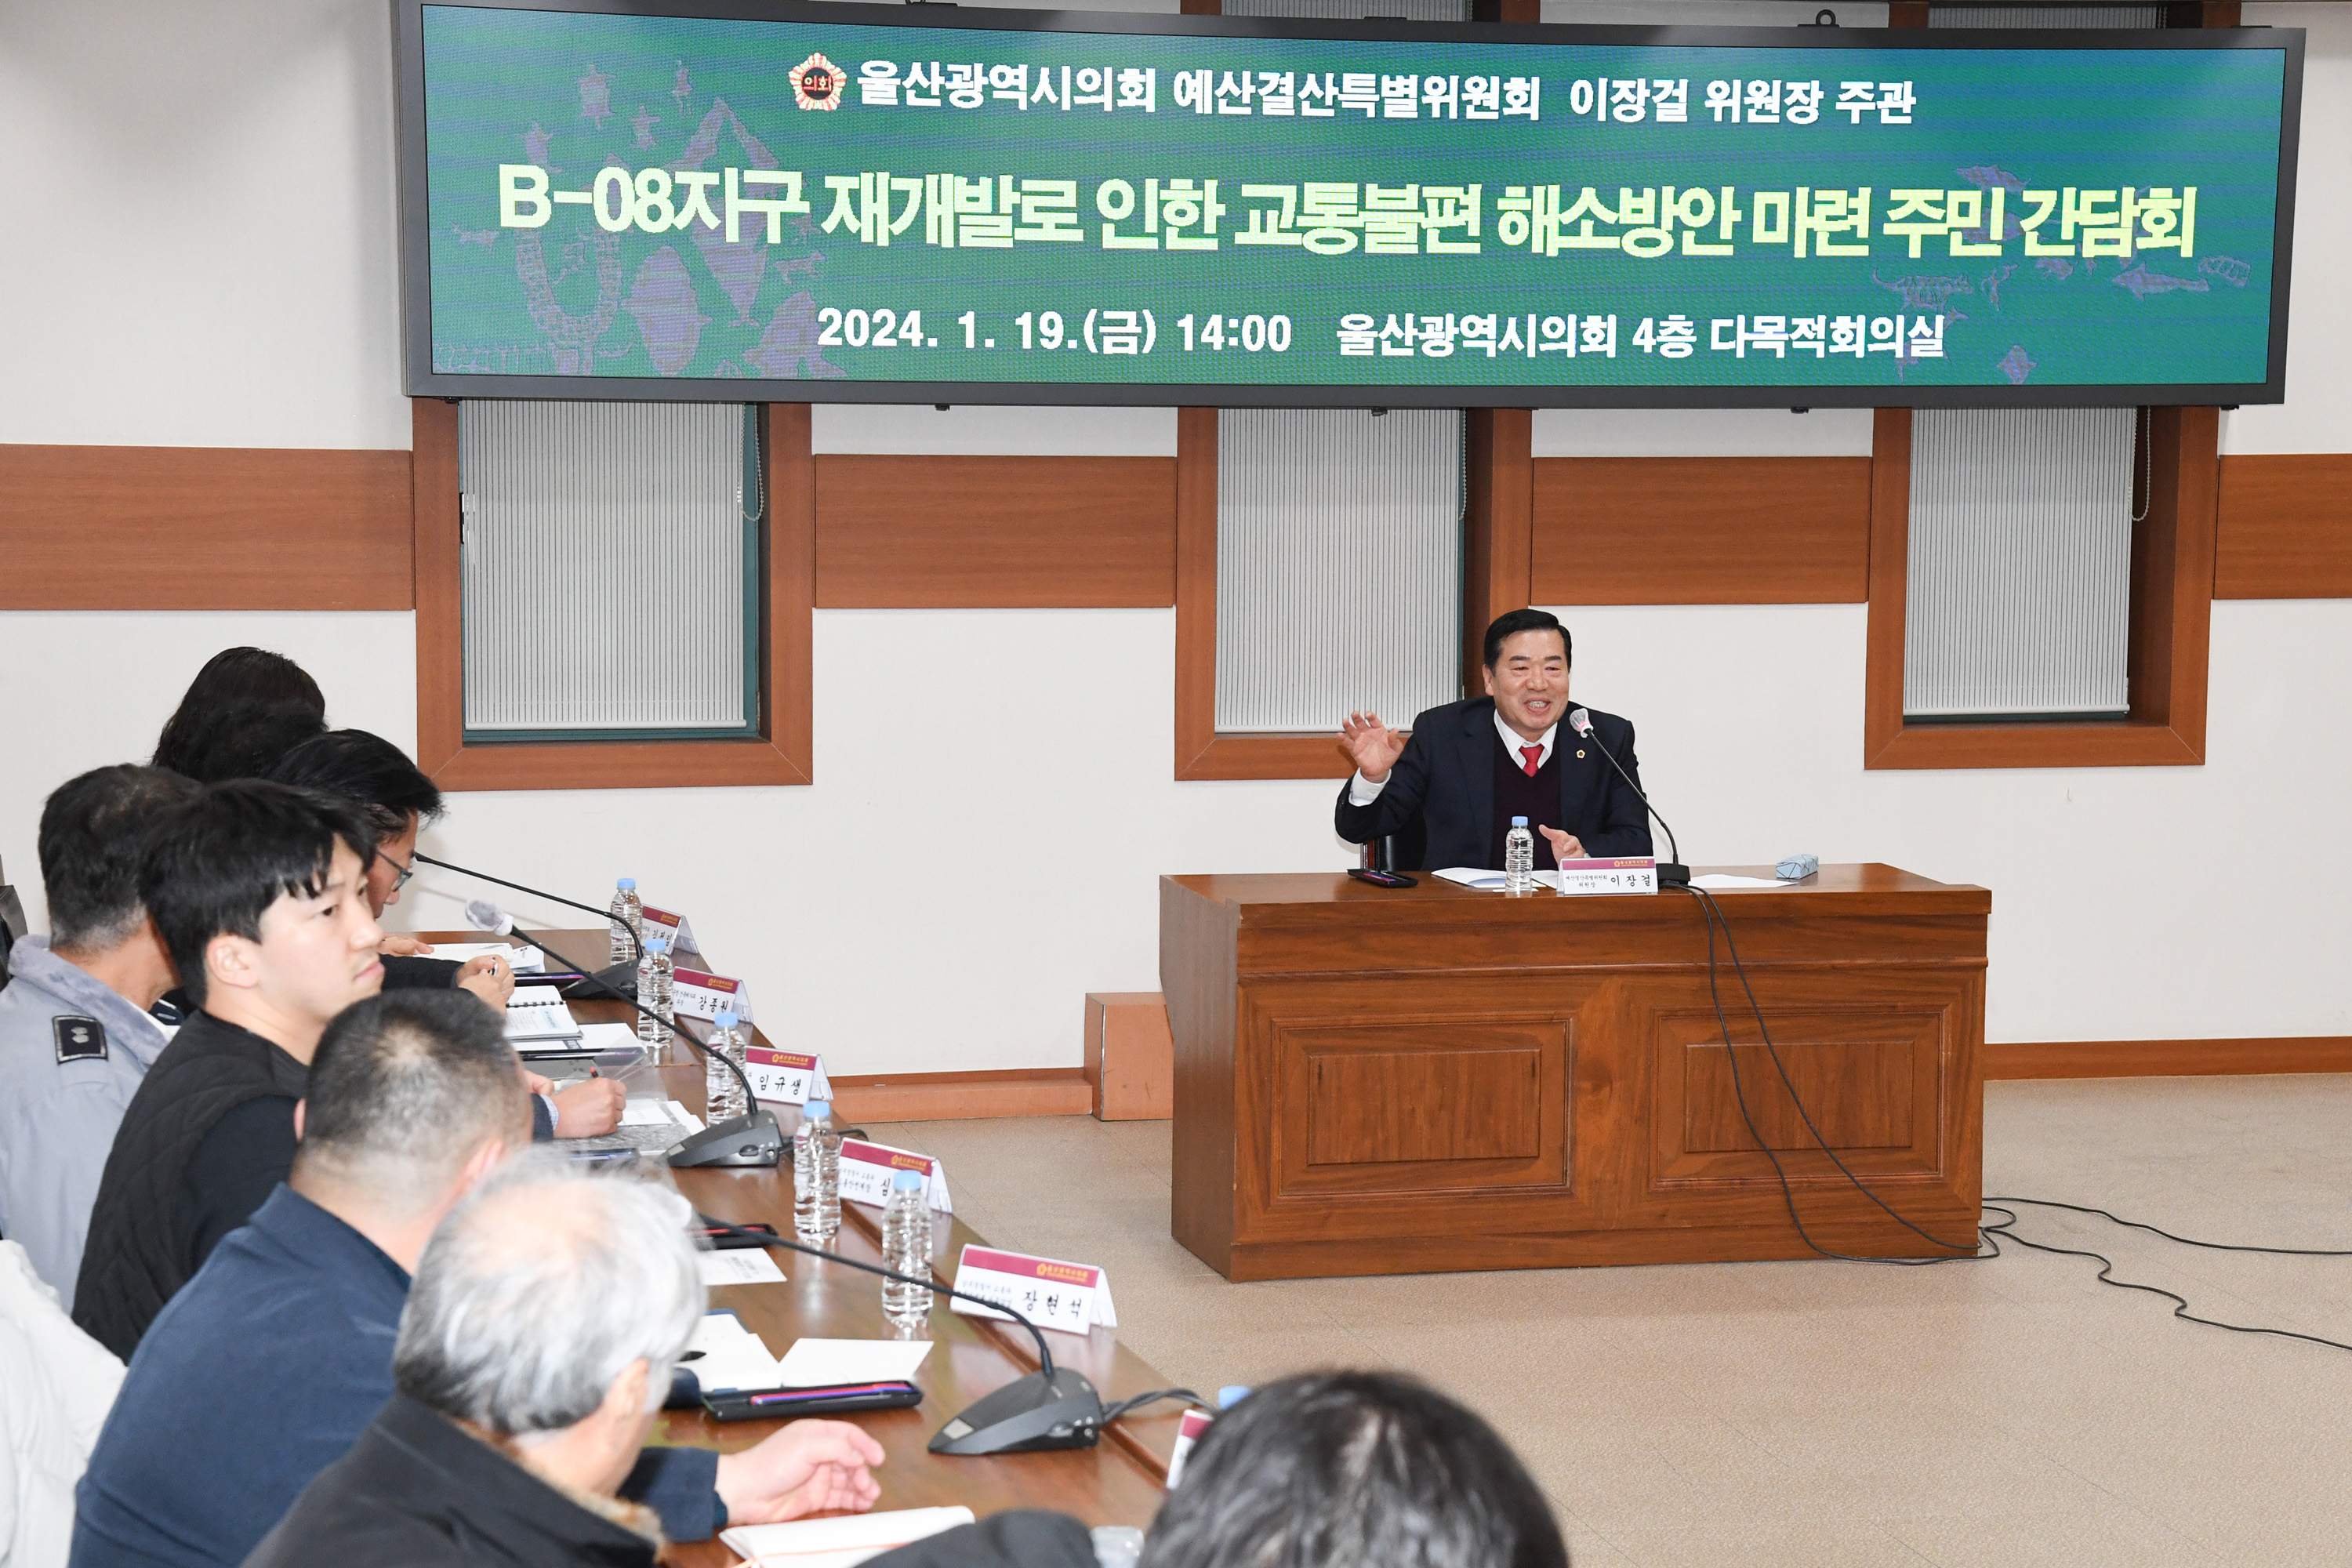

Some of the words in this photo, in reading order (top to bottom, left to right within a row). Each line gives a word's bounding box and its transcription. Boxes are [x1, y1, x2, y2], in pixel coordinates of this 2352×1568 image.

[857, 60, 1156, 113] 울산광역시의회
[1173, 69, 1541, 121] 예산결산특별위원회
[1570, 78, 1689, 123] 이장걸
[1704, 79, 1824, 125] 위원장
[1835, 81, 1917, 125] 주관
[499, 163, 811, 244] B-08지구
[820, 172, 1085, 248] 재개발로
[1096, 178, 1226, 251] 인한
[1234, 183, 1483, 255] 교통불편
[1497, 184, 1742, 258] 해소방안
[1752, 187, 1872, 258] 마련
[1883, 187, 2005, 258] 주민
[2020, 187, 2198, 258] 간담회
[817, 307, 938, 347] 2024.
[958, 310, 995, 349] 1.
[1015, 308, 1156, 355] 19.(금)
[1177, 314, 1292, 353] 14:00
[1336, 313, 1617, 358] 울산광역시의회
[1632, 314, 1698, 358] 4층
[1711, 314, 1945, 359] 다목적회의실
[1610, 873, 1651, 887] 이장걸
